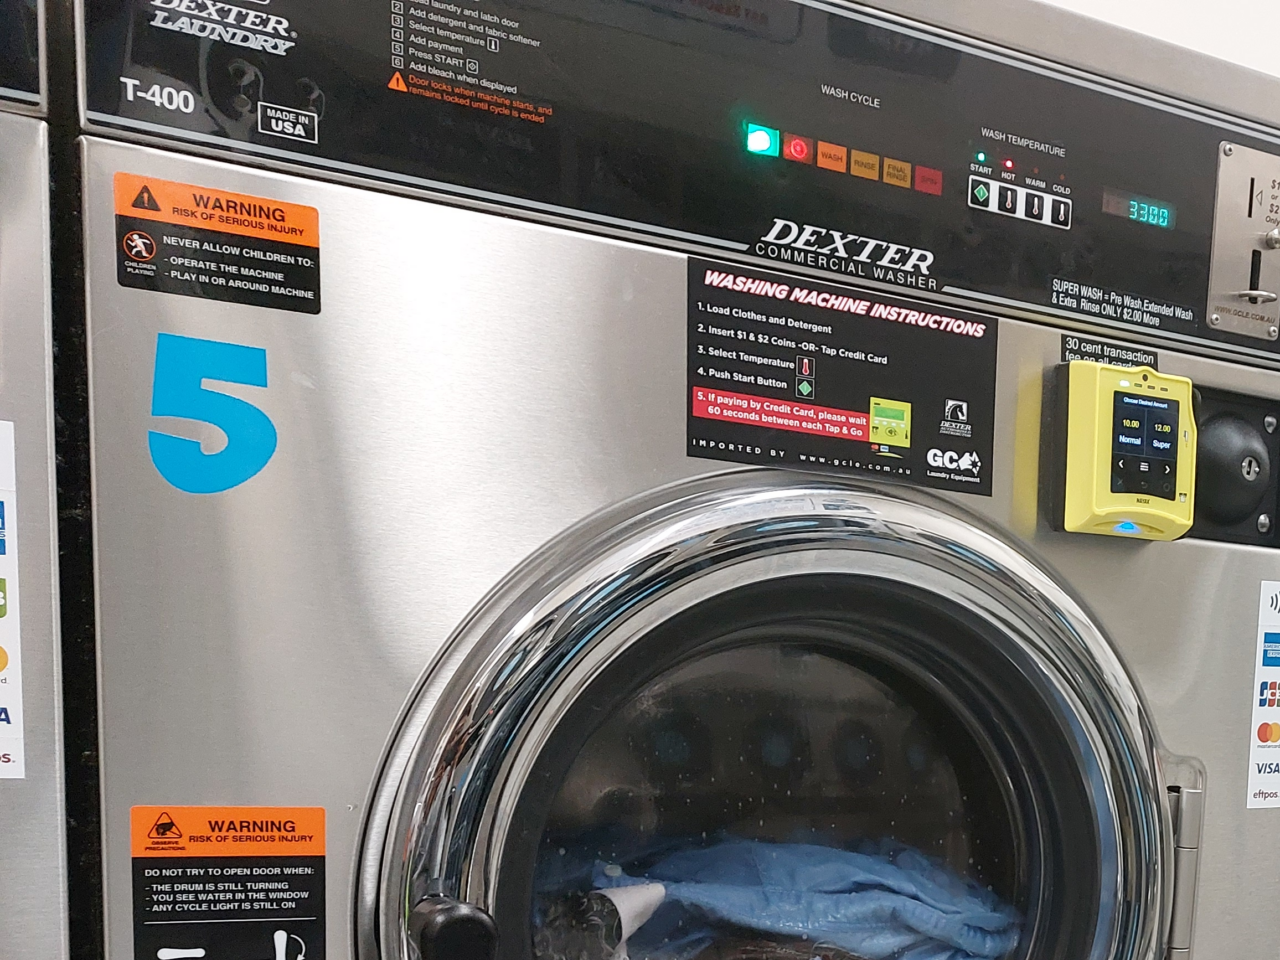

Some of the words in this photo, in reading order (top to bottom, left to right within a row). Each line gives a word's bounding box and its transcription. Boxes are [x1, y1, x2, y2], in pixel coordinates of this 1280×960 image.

[150, 10, 295, 56] LAUNDRY
[120, 77, 194, 113] T-400
[821, 84, 848, 100] WASH
[851, 92, 880, 108] CYCLE
[267, 109, 296, 122] MADE
[298, 115, 309, 124] IN
[271, 120, 306, 137] USA
[981, 127, 1005, 141] WASH
[1007, 135, 1066, 157] TEMPERATURE
[821, 151, 843, 163] WASH
[854, 159, 875, 171] RINSE
[888, 163, 906, 174] FINAL
[887, 171, 908, 183] RINSE
[970, 163, 992, 175] START
[1002, 171, 1015, 181] HOT
[1025, 177, 1046, 189] WARM
[1053, 184, 1070, 195] COLD
[1271, 179, 1280, 190] $1
[192, 193, 285, 223] WARNING
[1269, 203, 1279, 214] $2
[173, 207, 198, 219] RISK
[201, 212, 215, 221] OF
[218, 215, 265, 230] SERIOUS
[268, 223, 304, 237] INJURY
[1265, 215, 1280, 226] Only
[163, 235, 199, 249] NEVER
[202, 242, 240, 256] ALLOW
[243, 249, 295, 264] CHILDREN
[297, 257, 315, 268] TO:
[761, 218, 934, 275] DEXTER
[170, 256, 217, 271] OPERATE
[219, 263, 237, 274] THE
[241, 266, 284, 281] MACHINE
[755, 243, 866, 276] COMMERCIAL
[874, 267, 937, 290] WASHER
[171, 270, 196, 282] PLAY
[199, 275, 209, 283] IN
[211, 276, 226, 286] OR
[228, 279, 269, 292] AROUND
[272, 286, 314, 299] MACHINE
[703, 270, 788, 299] WASHING
[790, 288, 870, 316] MACHINE
[869, 305, 986, 338] INSTRUCTIONS
[1052, 278, 1079, 295] SUPER
[1081, 285, 1102, 300] WASH
[1110, 292, 1122, 306] Pre
[1175, 307, 1193, 321] Wash
[1052, 292, 1057, 304] &
[1059, 294, 1077, 308] Extra
[1080, 299, 1100, 313] Rinse
[1101, 304, 1121, 318] ONLY
[1123, 308, 1142, 322] $2.00
[1143, 312, 1160, 326] More
[698, 302, 704, 311] 1.
[707, 304, 730, 316] Load
[732, 308, 766, 322] Clothes
[769, 316, 785, 325] and
[788, 318, 832, 334] Detergent
[698, 324, 706, 333] 2.
[709, 326, 734, 338] Insert
[737, 331, 746, 340] $1
[749, 332, 755, 341] &
[758, 334, 769, 344] $2
[771, 337, 795, 349] Coins
[821, 346, 836, 356] Tap
[839, 349, 865, 361] Credit
[868, 353, 887, 364] Card
[1066, 337, 1079, 350] 30
[1081, 341, 1101, 353] cent
[1104, 345, 1154, 364] transaction
[698, 345, 706, 354] 3.
[708, 347, 737, 359] Select
[739, 352, 795, 369] Temperature
[1066, 351, 1080, 361] fee
[697, 367, 707, 376] 4.
[709, 369, 730, 380] Push
[733, 373, 755, 383] Start
[757, 377, 787, 389] Button
[148, 333, 277, 494] 5
[697, 392, 706, 400] 5.
[708, 393, 715, 402] If
[717, 395, 748, 410] paying
[750, 398, 761, 410] by
[764, 402, 791, 415] Credit
[793, 407, 817, 419] Card,
[819, 411, 846, 424] please
[848, 416, 866, 426] wait
[708, 406, 720, 415] 60
[723, 408, 759, 421] seconds
[762, 414, 799, 427] between
[802, 420, 822, 431] each
[825, 423, 840, 434] Tap
[842, 426, 849, 435] &
[850, 426, 863, 436] Go
[940, 421, 972, 430] DEXTER
[1123, 419, 1140, 428] 10.00
[1154, 424, 1171, 433] 12.00
[692, 438, 761, 454] IMPORTED
[770, 449, 785, 458] BY
[1119, 435, 1141, 445] Normal
[1153, 440, 1171, 449] Super
[927, 470, 949, 479] Laundry
[951, 474, 980, 483] Equipment
[1255, 762, 1280, 774] VISA
[208, 820, 296, 833] WARNING
[189, 835, 212, 843] RISK
[215, 835, 229, 843] OF
[232, 834, 276, 843] SERIOUS
[279, 834, 314, 843] INJURY
[144, 869, 160, 877] DO
[162, 869, 183, 877] NOT
[186, 868, 204, 876] TRY
[208, 868, 221, 876] TO
[223, 868, 250, 876] OPEN
[253, 867, 281, 875] DOOR
[283, 867, 315, 875] WHEN:
